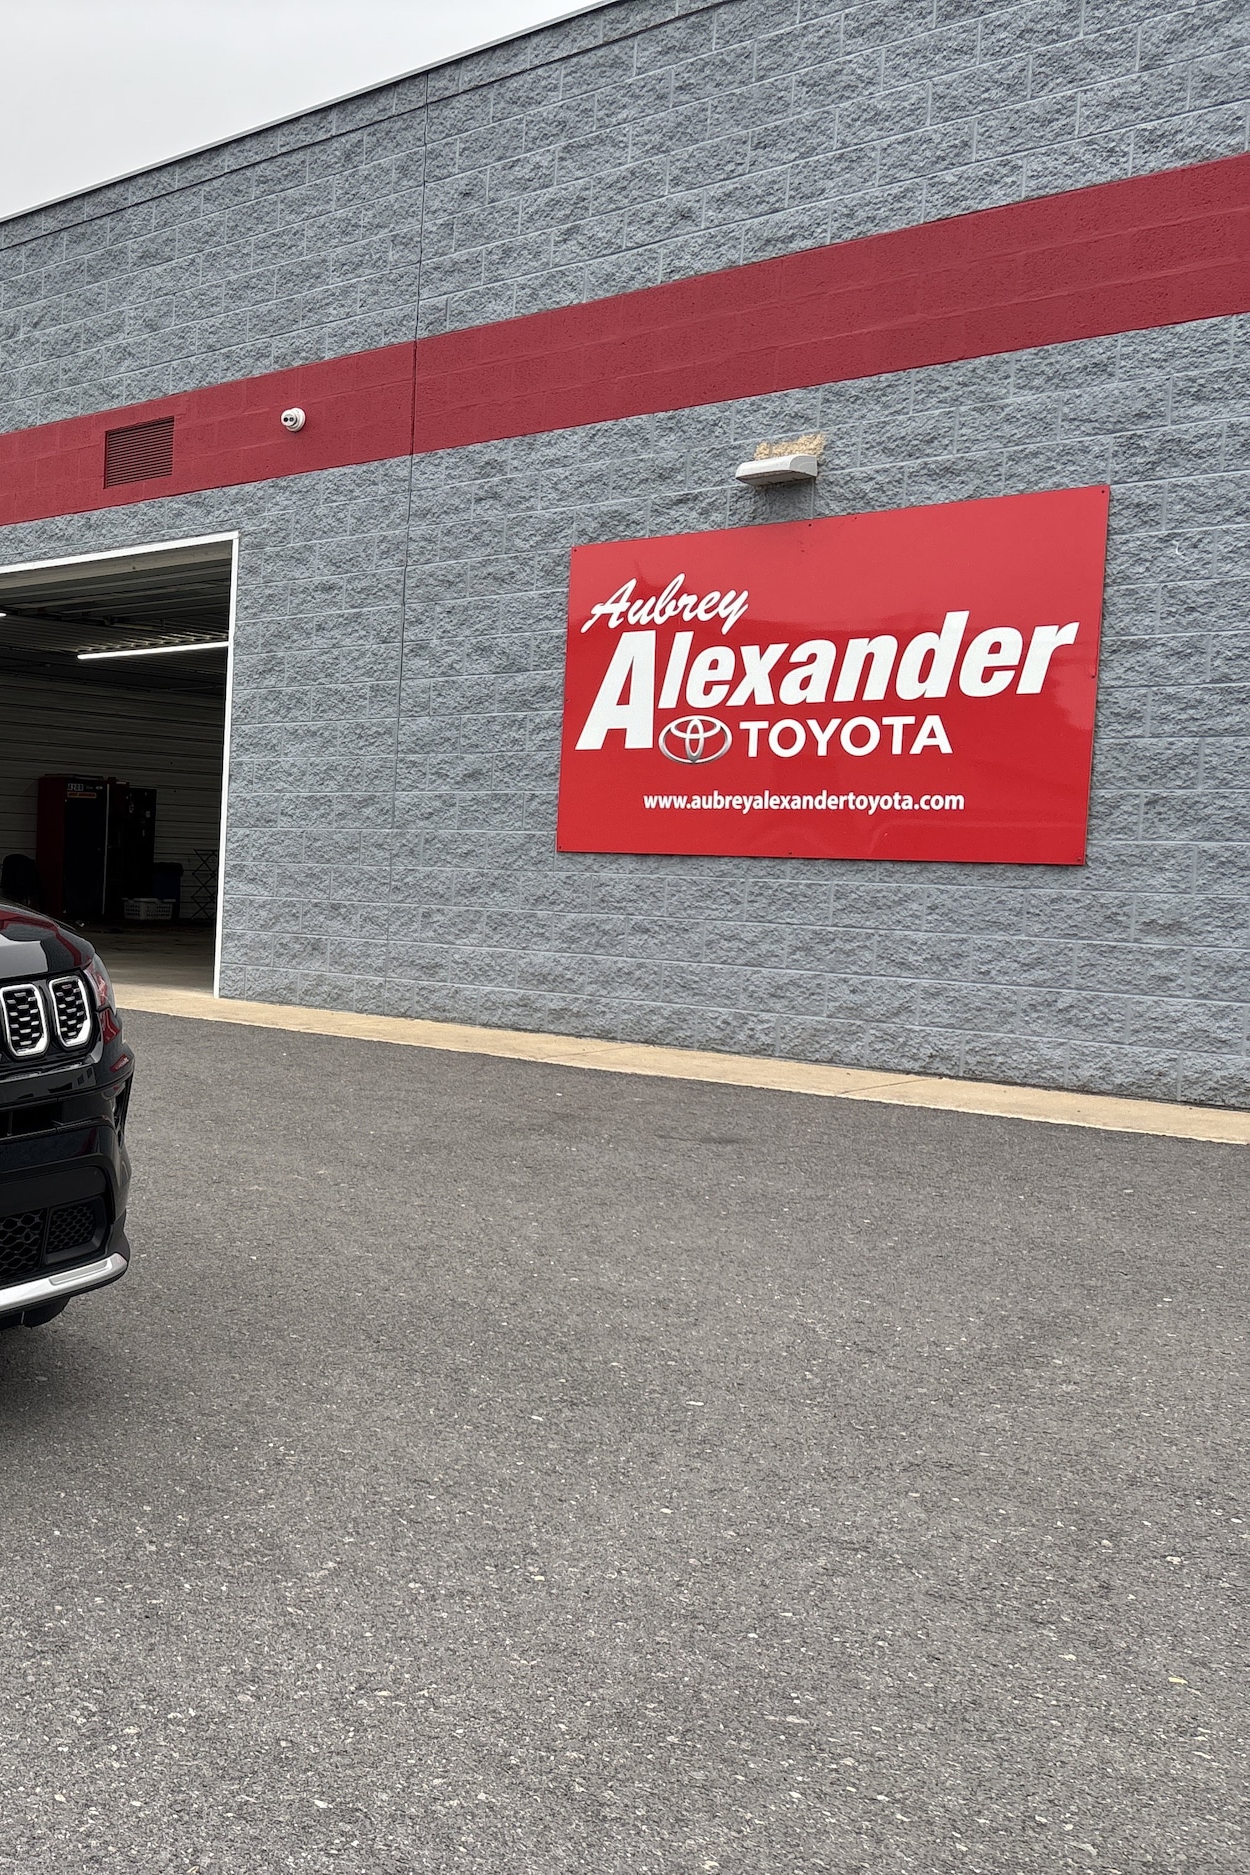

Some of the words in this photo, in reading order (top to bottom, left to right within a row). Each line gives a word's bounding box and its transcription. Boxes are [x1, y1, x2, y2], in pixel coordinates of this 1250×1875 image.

[575, 573, 749, 634] Aubrey
[575, 611, 1080, 751] Alexander
[739, 715, 953, 758] TOYOTA
[643, 790, 965, 815] www.aubreyalexandertoyota.com
